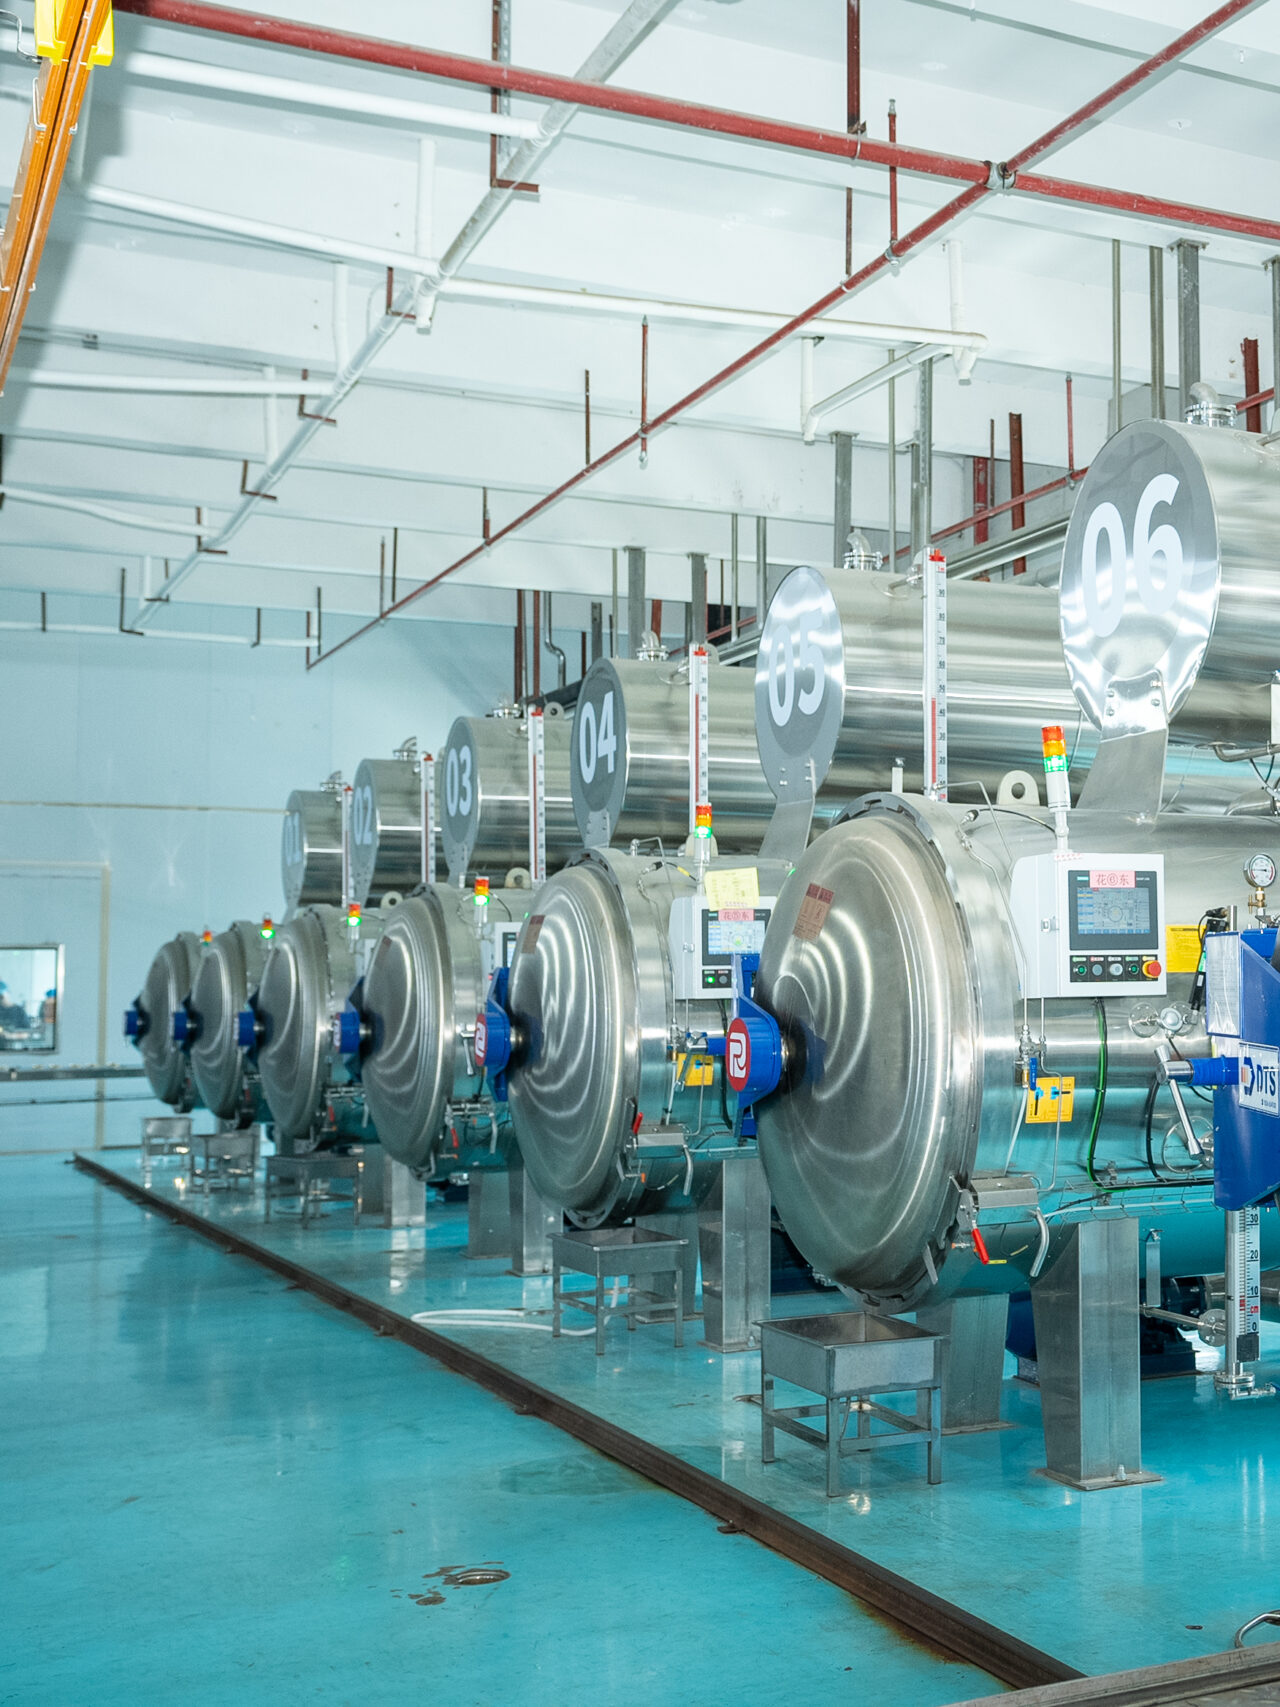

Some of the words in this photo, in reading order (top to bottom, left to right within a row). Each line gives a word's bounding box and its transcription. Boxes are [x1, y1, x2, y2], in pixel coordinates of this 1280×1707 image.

[1081, 473, 1184, 638] 06
[768, 607, 825, 727] 05
[579, 691, 616, 784] 04
[446, 745, 472, 817] 03
[284, 812, 300, 866] 01
[354, 785, 372, 845] 02
[1256, 1064, 1276, 1097] DTS
[1250, 1214, 1258, 1224] 30
[1250, 1250, 1258, 1259] 20
[1250, 1286, 1258, 1295] 10
[1252, 1322, 1257, 1331] 0
